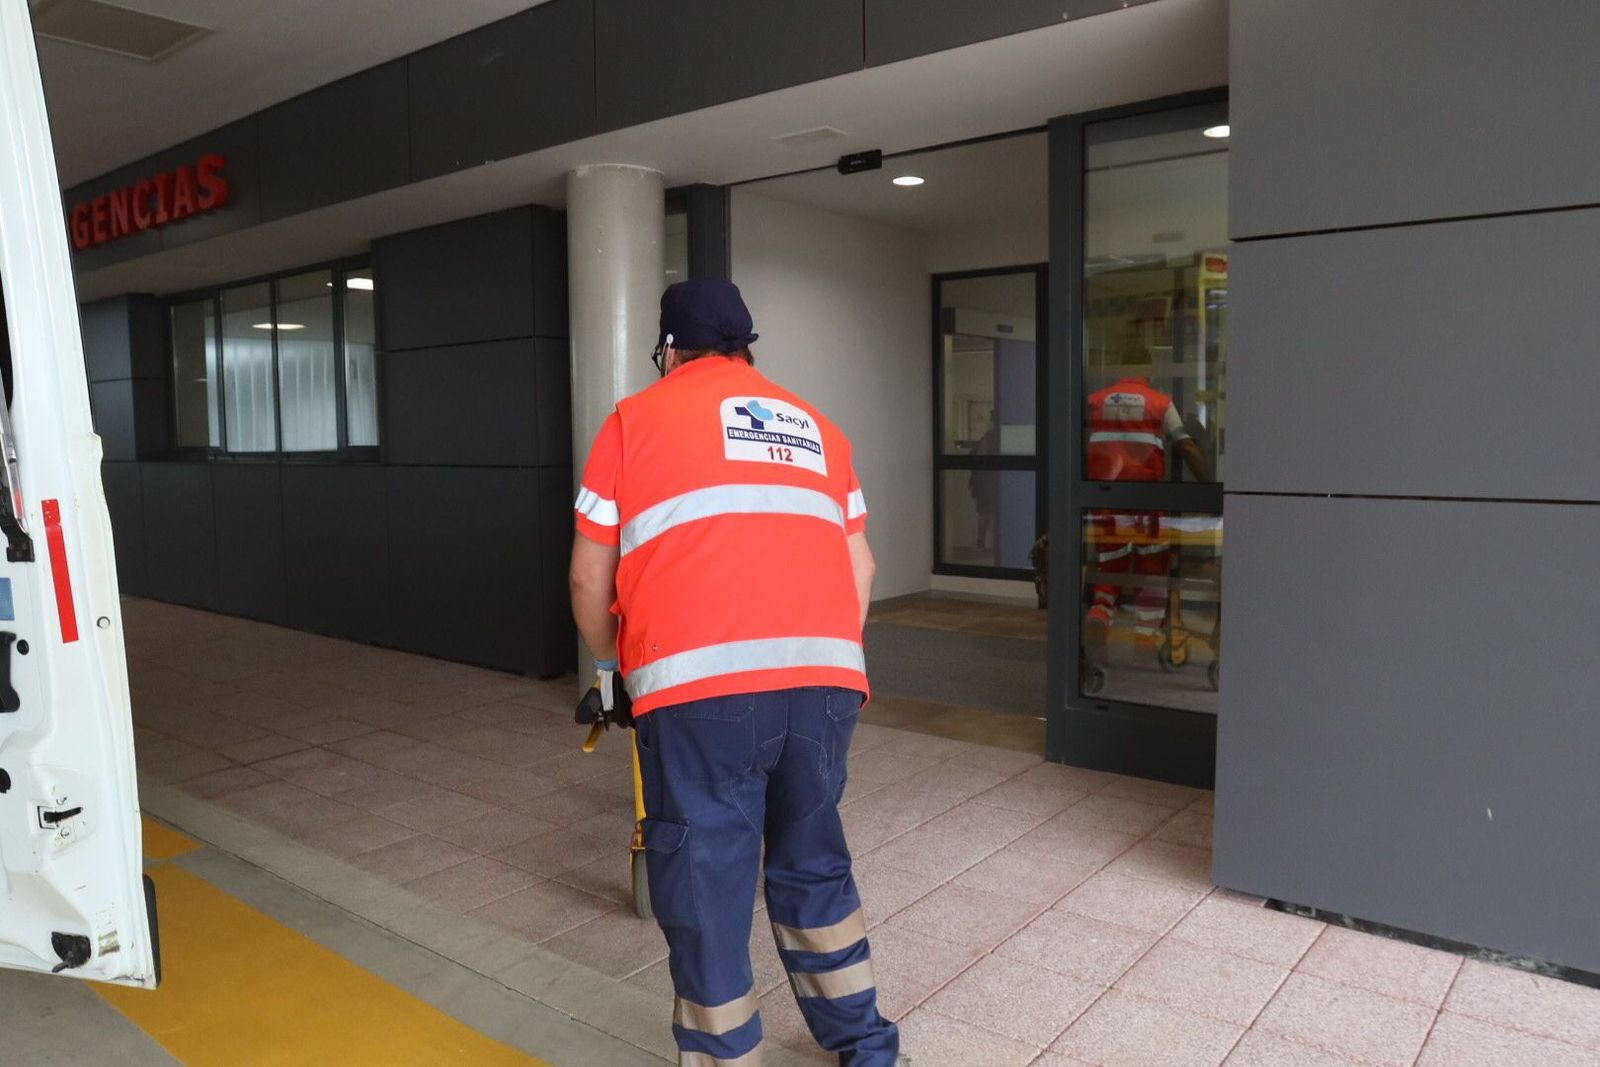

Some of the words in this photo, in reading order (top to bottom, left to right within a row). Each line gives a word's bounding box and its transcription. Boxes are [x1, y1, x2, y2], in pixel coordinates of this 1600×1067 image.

[70, 153, 228, 249] GENCIAS
[776, 413, 809, 429] Sacyl
[728, 429, 781, 442] EMERGENCIAS
[782, 435, 820, 452] SANITARIAS
[767, 446, 793, 462] 112
